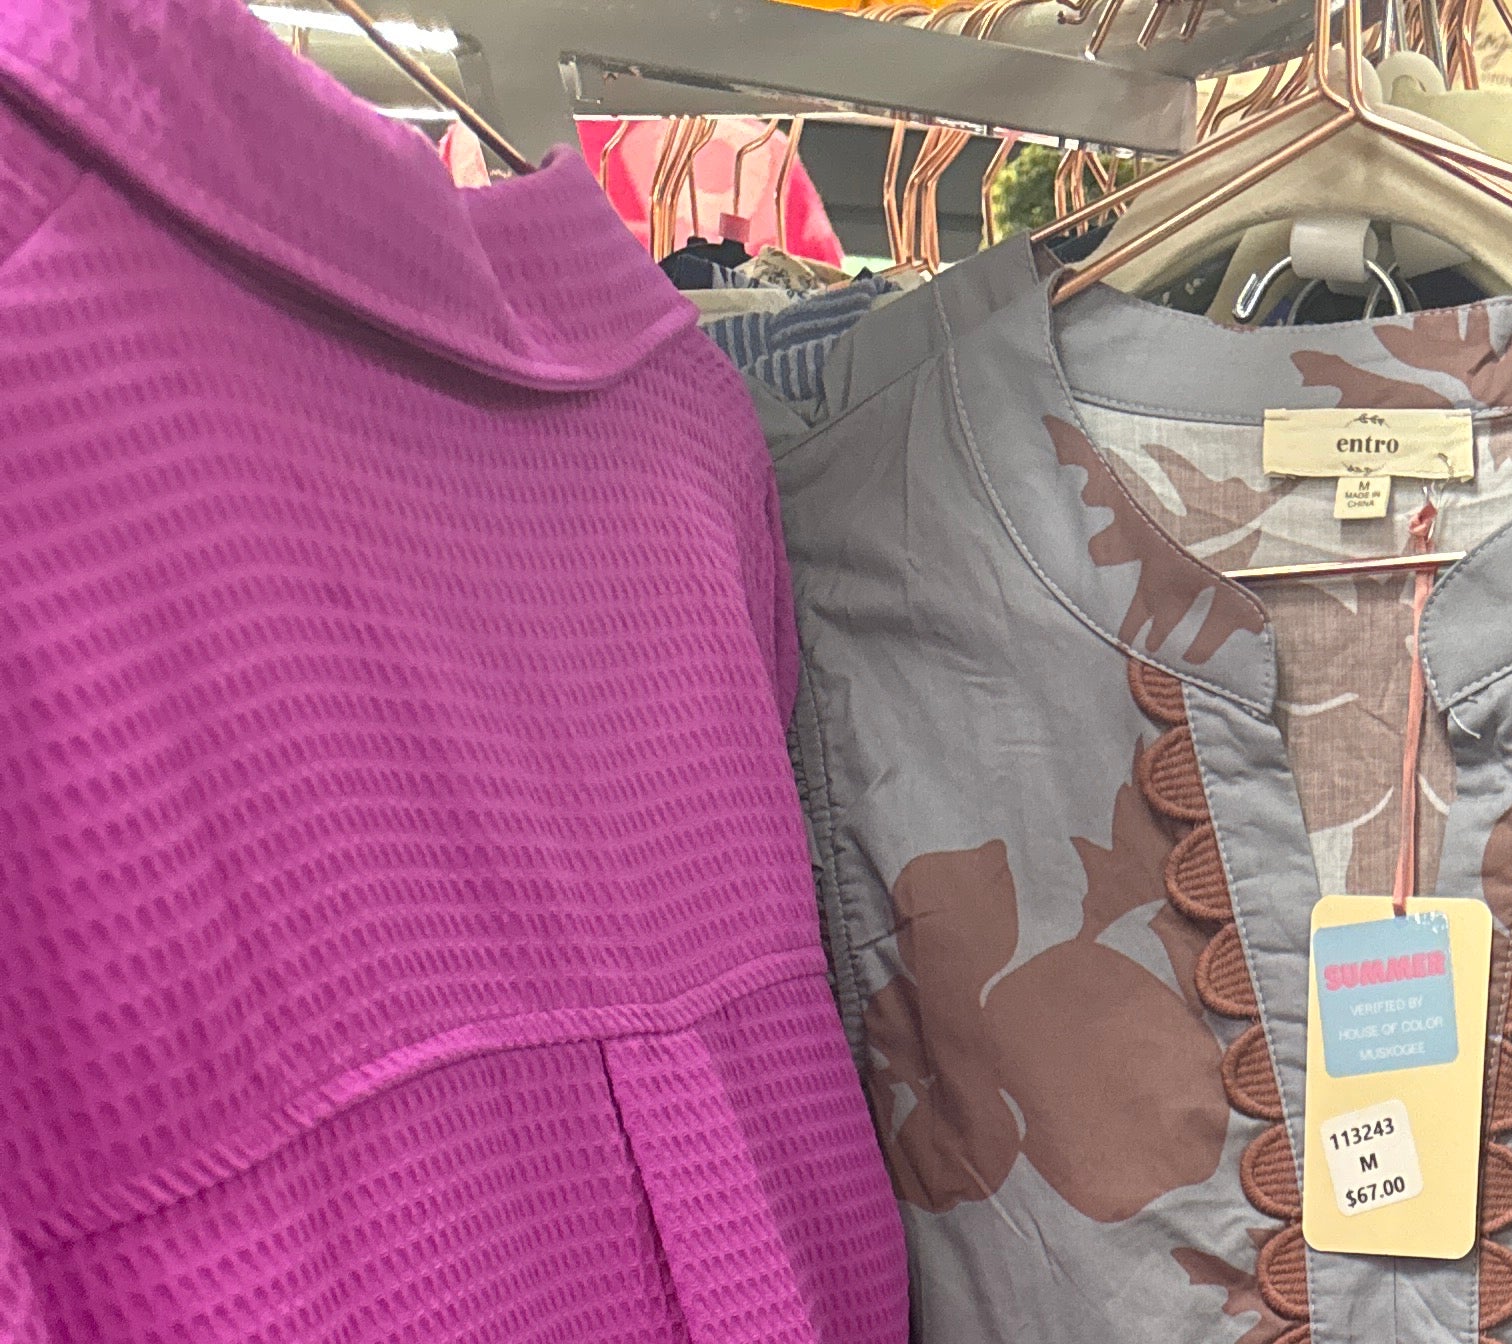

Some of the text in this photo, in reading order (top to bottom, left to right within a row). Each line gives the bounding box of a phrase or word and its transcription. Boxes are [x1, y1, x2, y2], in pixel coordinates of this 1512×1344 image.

[1336, 434, 1399, 454] entro
[1358, 480, 1370, 491] M
[1347, 499, 1375, 509] CHINA
[1323, 949, 1446, 992] SUMMER
[1349, 995, 1423, 1018] VERIFIED BY
[1338, 1015, 1444, 1042] HOUSE OF COLOR
[1359, 1041, 1426, 1062] MUSKOGEE
[1329, 1117, 1395, 1151] 113243
[1359, 1153, 1379, 1173] M
[1345, 1176, 1406, 1209] $67.00
